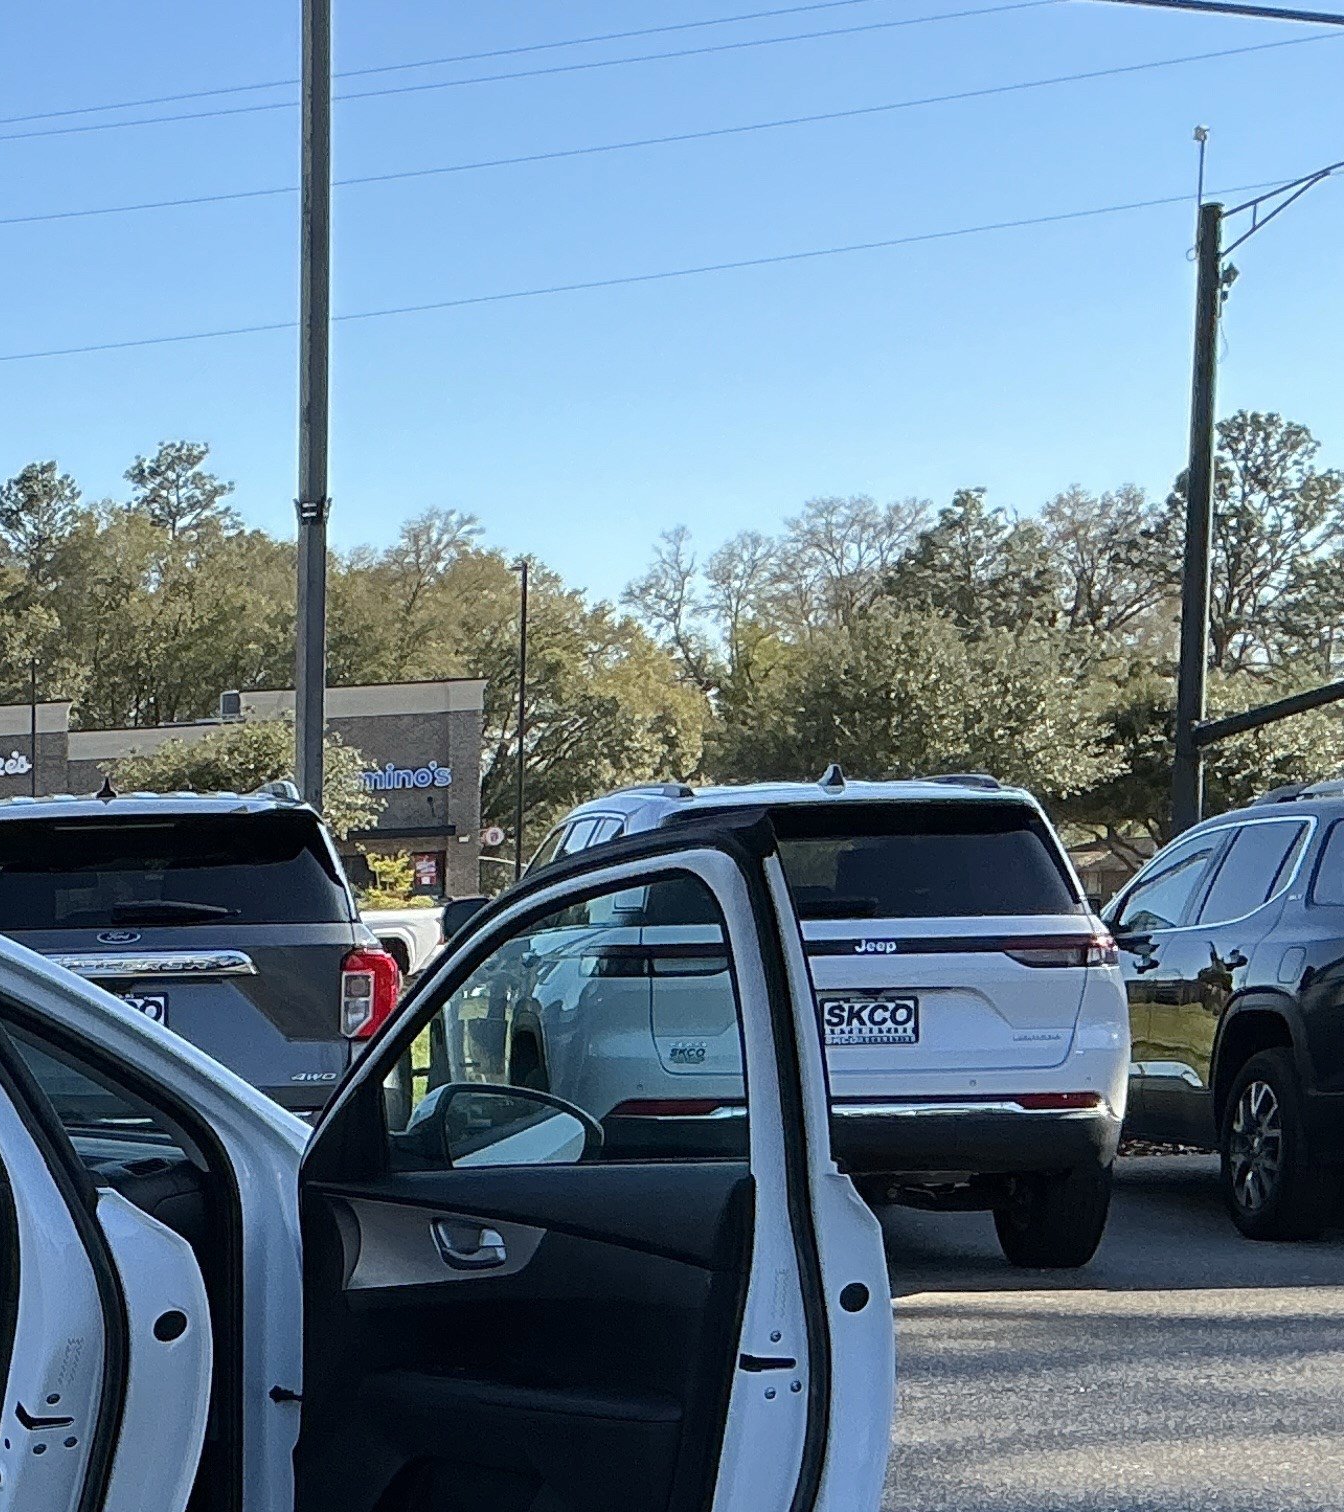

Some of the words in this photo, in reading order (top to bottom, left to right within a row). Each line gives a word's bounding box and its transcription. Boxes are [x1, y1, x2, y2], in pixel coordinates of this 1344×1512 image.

[358, 760, 453, 791] mino's
[855, 940, 897, 954] Jeep
[825, 1003, 914, 1027] SKCO
